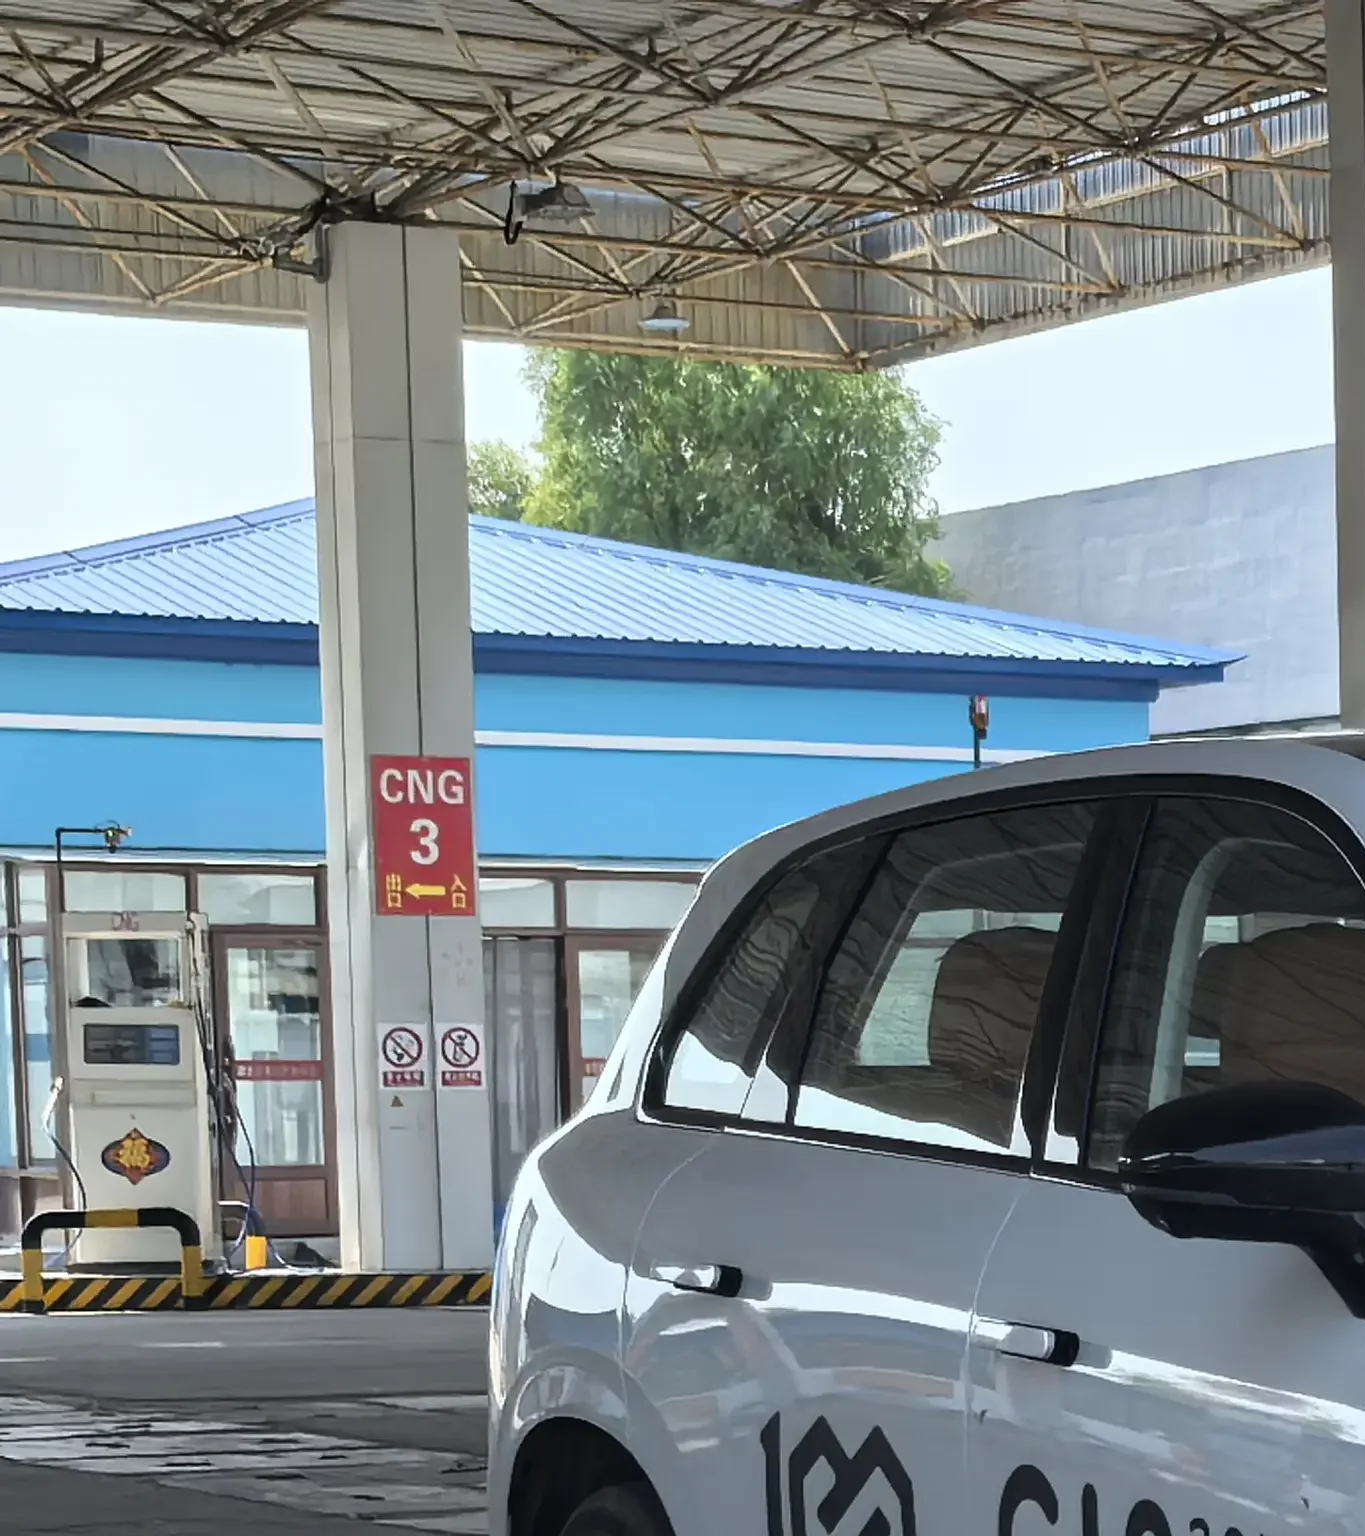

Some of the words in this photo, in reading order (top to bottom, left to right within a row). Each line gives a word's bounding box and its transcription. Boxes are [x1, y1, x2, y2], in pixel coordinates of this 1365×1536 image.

[379, 768, 464, 804] CNG
[410, 818, 439, 866] 3
[386, 874, 402, 908] 出口
[451, 874, 467, 908] 入口
